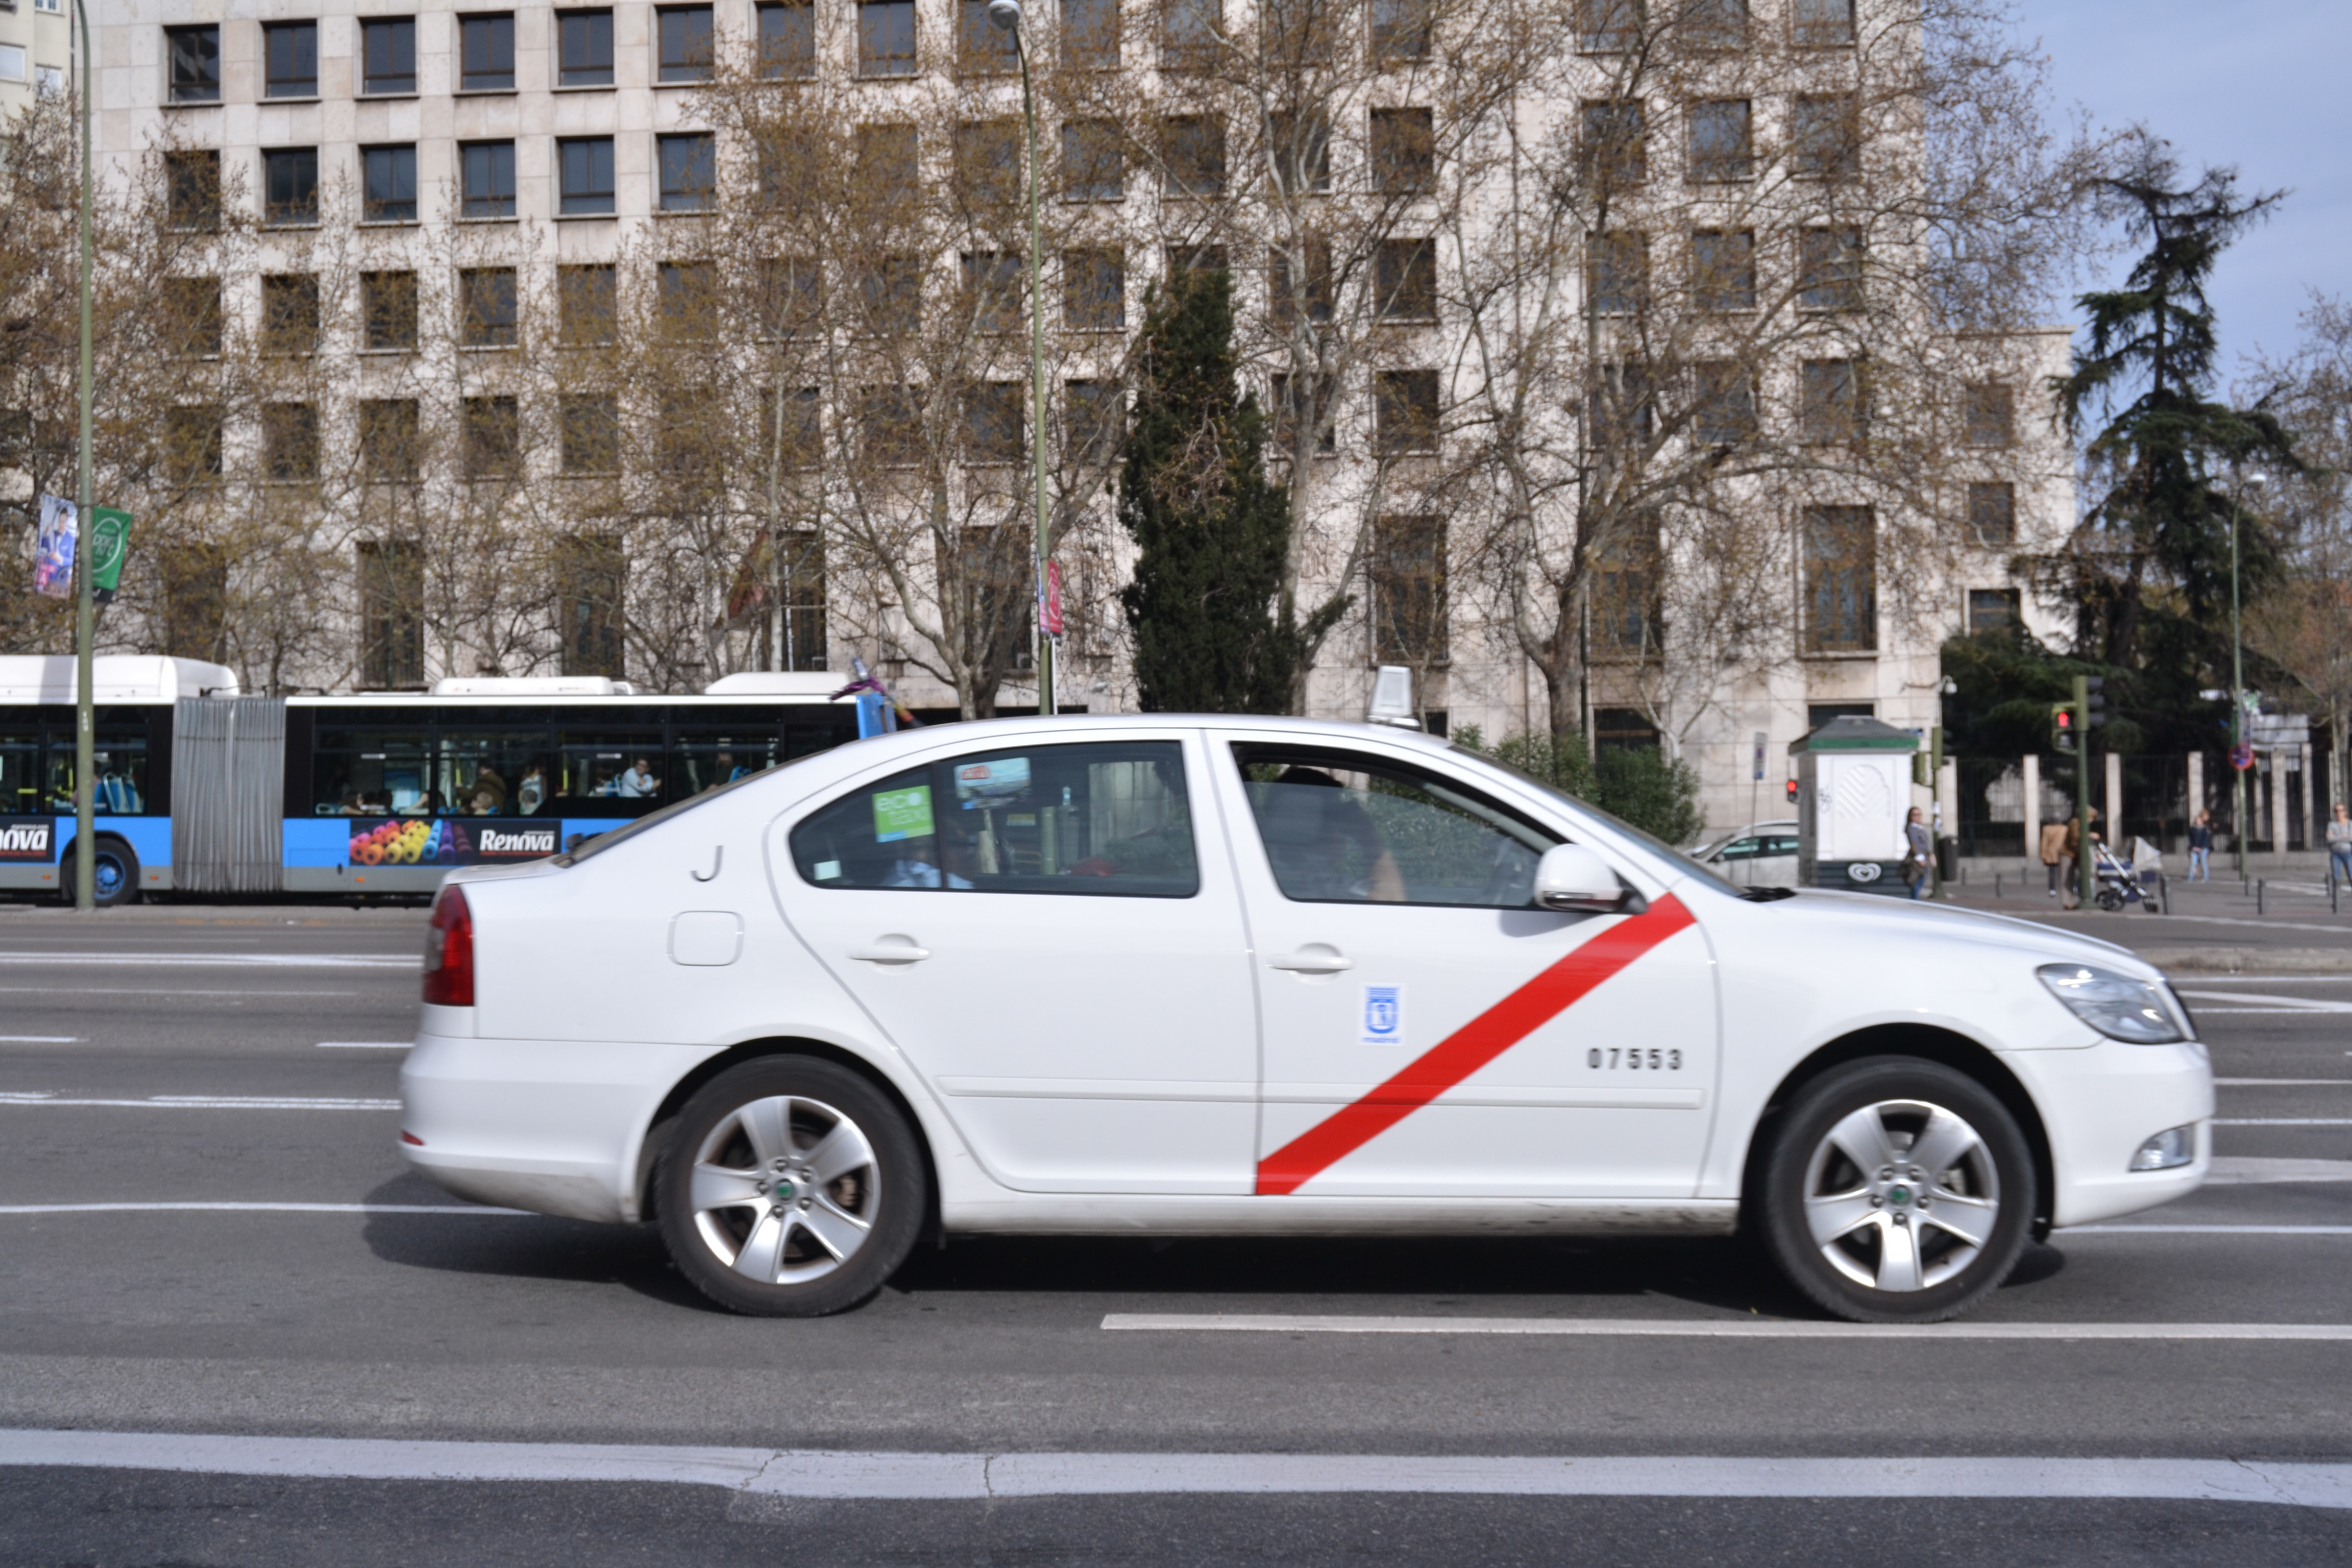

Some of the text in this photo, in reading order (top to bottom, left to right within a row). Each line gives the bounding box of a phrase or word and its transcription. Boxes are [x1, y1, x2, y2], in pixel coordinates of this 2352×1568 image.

[874, 793, 922, 812] eco
[888, 801, 931, 825] taxi
[480, 829, 554, 851] Renova
[1587, 1048, 1682, 1069] 07553
